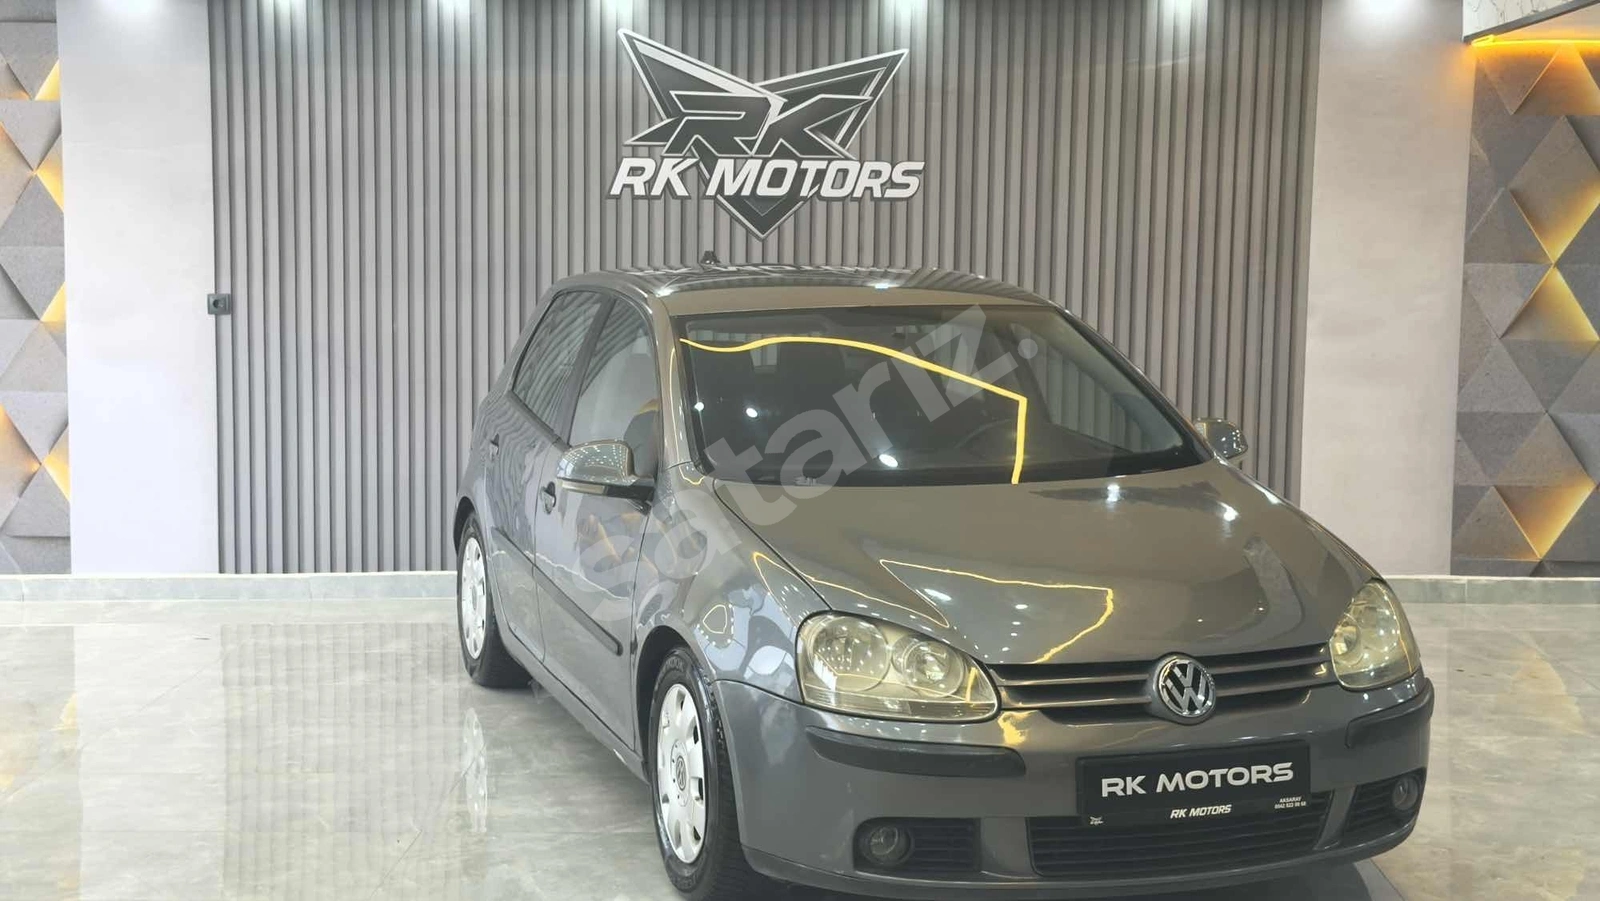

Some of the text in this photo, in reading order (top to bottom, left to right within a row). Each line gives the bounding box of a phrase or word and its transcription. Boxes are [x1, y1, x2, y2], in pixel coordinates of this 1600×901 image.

[609, 157, 925, 199] RK MOTORS
[1101, 762, 1294, 798] RK MOTORS
[1170, 804, 1233, 819] RK MOTORS
